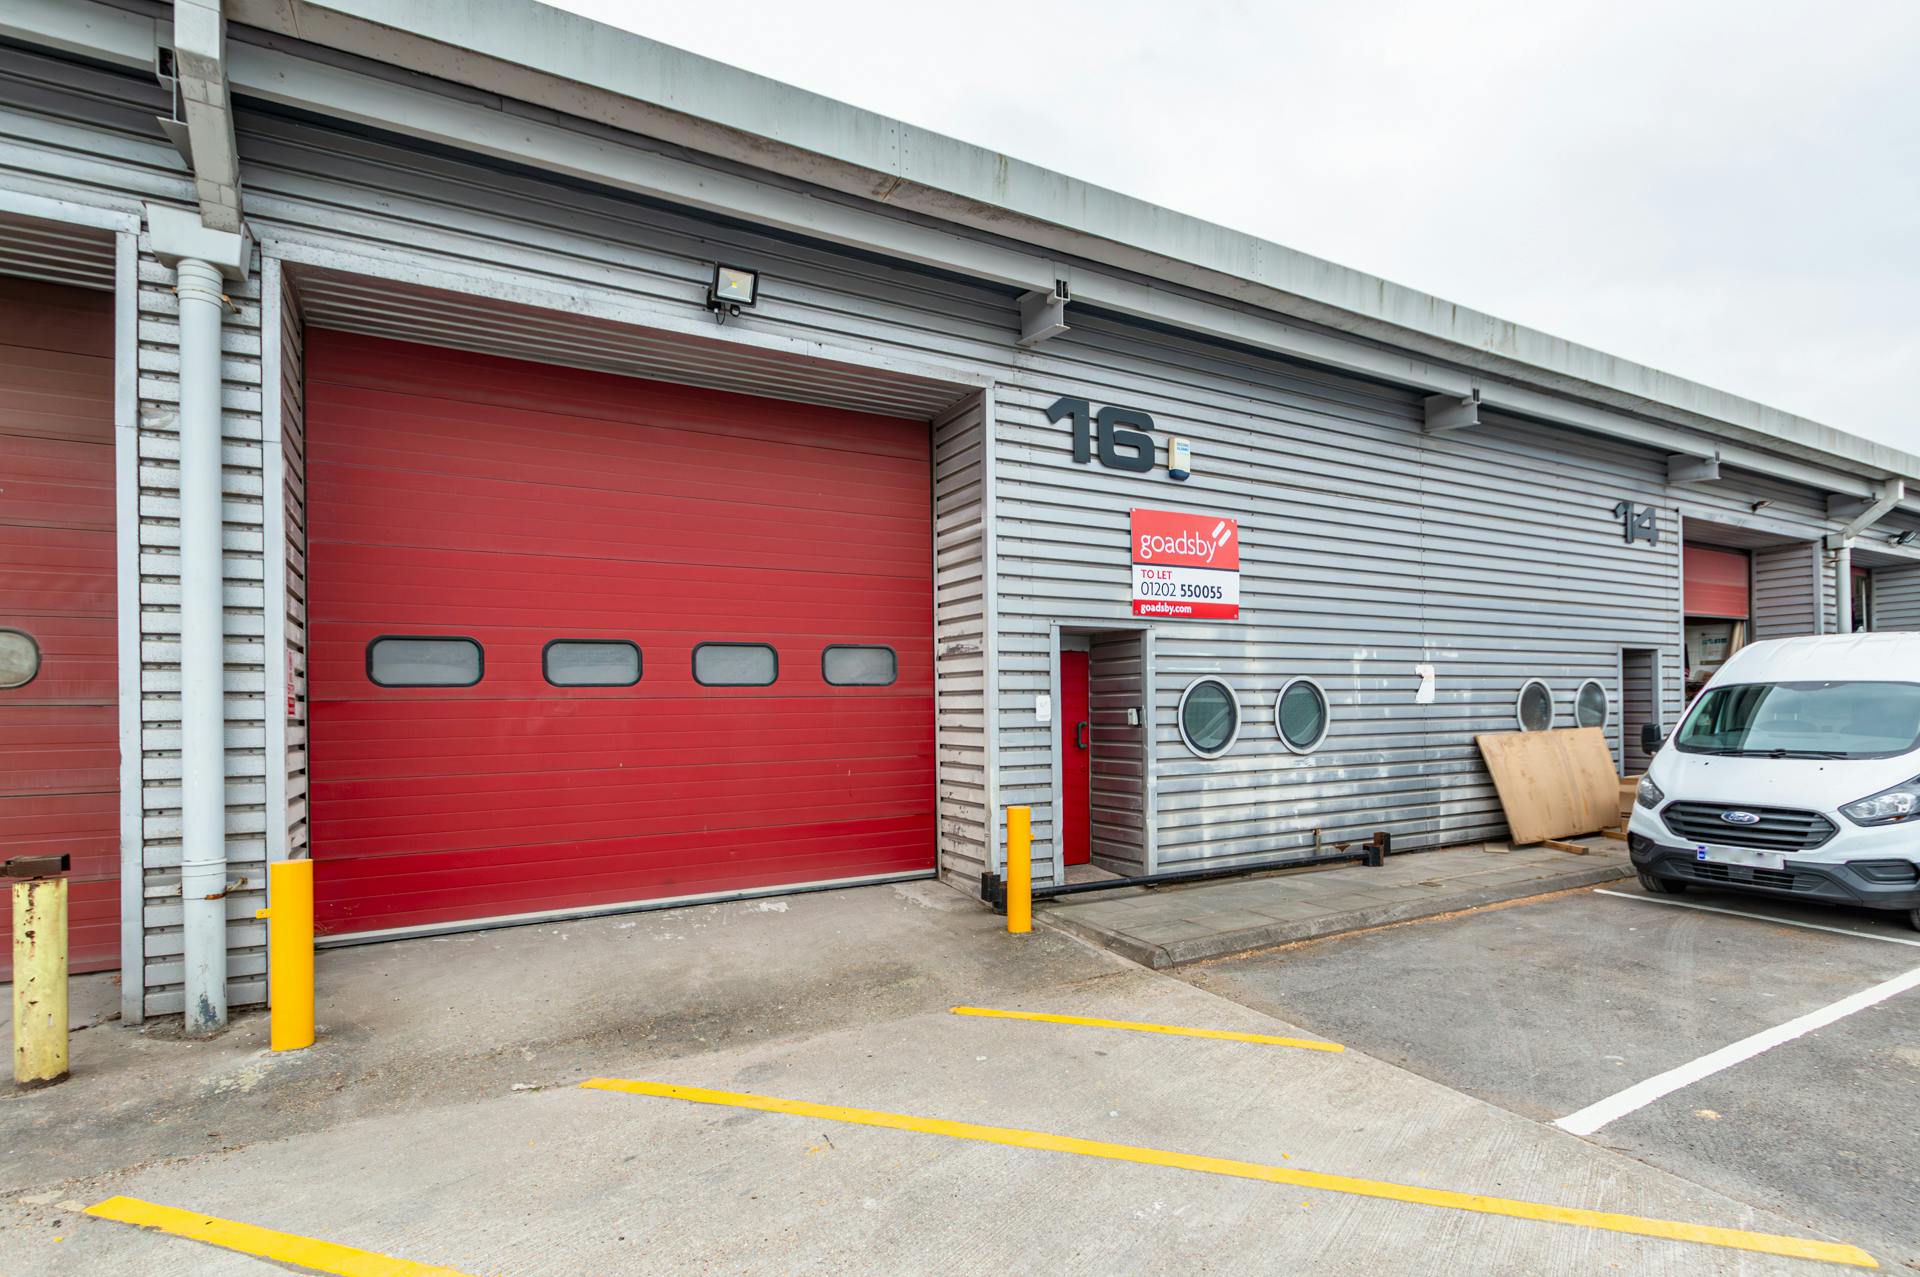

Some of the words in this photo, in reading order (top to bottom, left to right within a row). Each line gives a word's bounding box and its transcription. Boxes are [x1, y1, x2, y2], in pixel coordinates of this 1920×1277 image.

[1045, 396, 1155, 473] 16
[1614, 501, 1659, 547] 14
[1140, 530, 1217, 563] goadsby
[1141, 569, 1154, 579] TO
[1157, 570, 1172, 580] LET
[1141, 581, 1176, 597] 01202
[1180, 583, 1222, 599] 550055
[1140, 602, 1192, 615] goadsby.com
